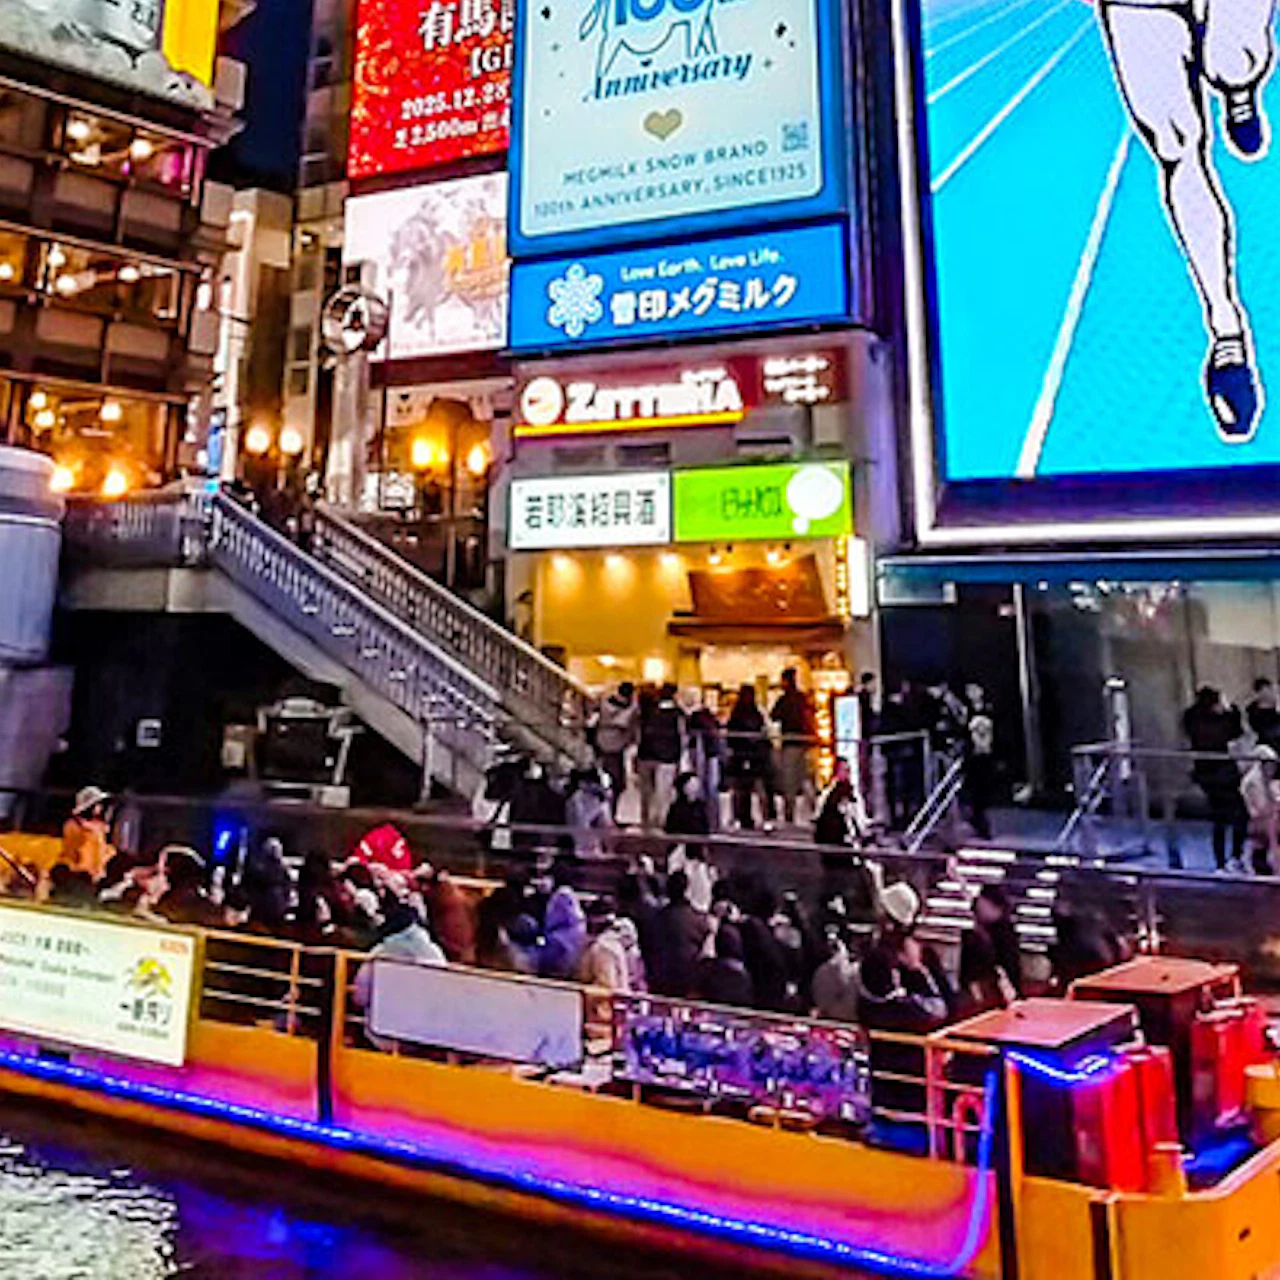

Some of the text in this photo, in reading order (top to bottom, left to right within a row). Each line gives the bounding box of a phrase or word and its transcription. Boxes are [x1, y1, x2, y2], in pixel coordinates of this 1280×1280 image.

[582, 54, 752, 102] Anniversary
[646, 153, 696, 173] SNOW
[704, 140, 768, 165] BRAND
[610, 274, 798, 325] 雪印メグミルク
